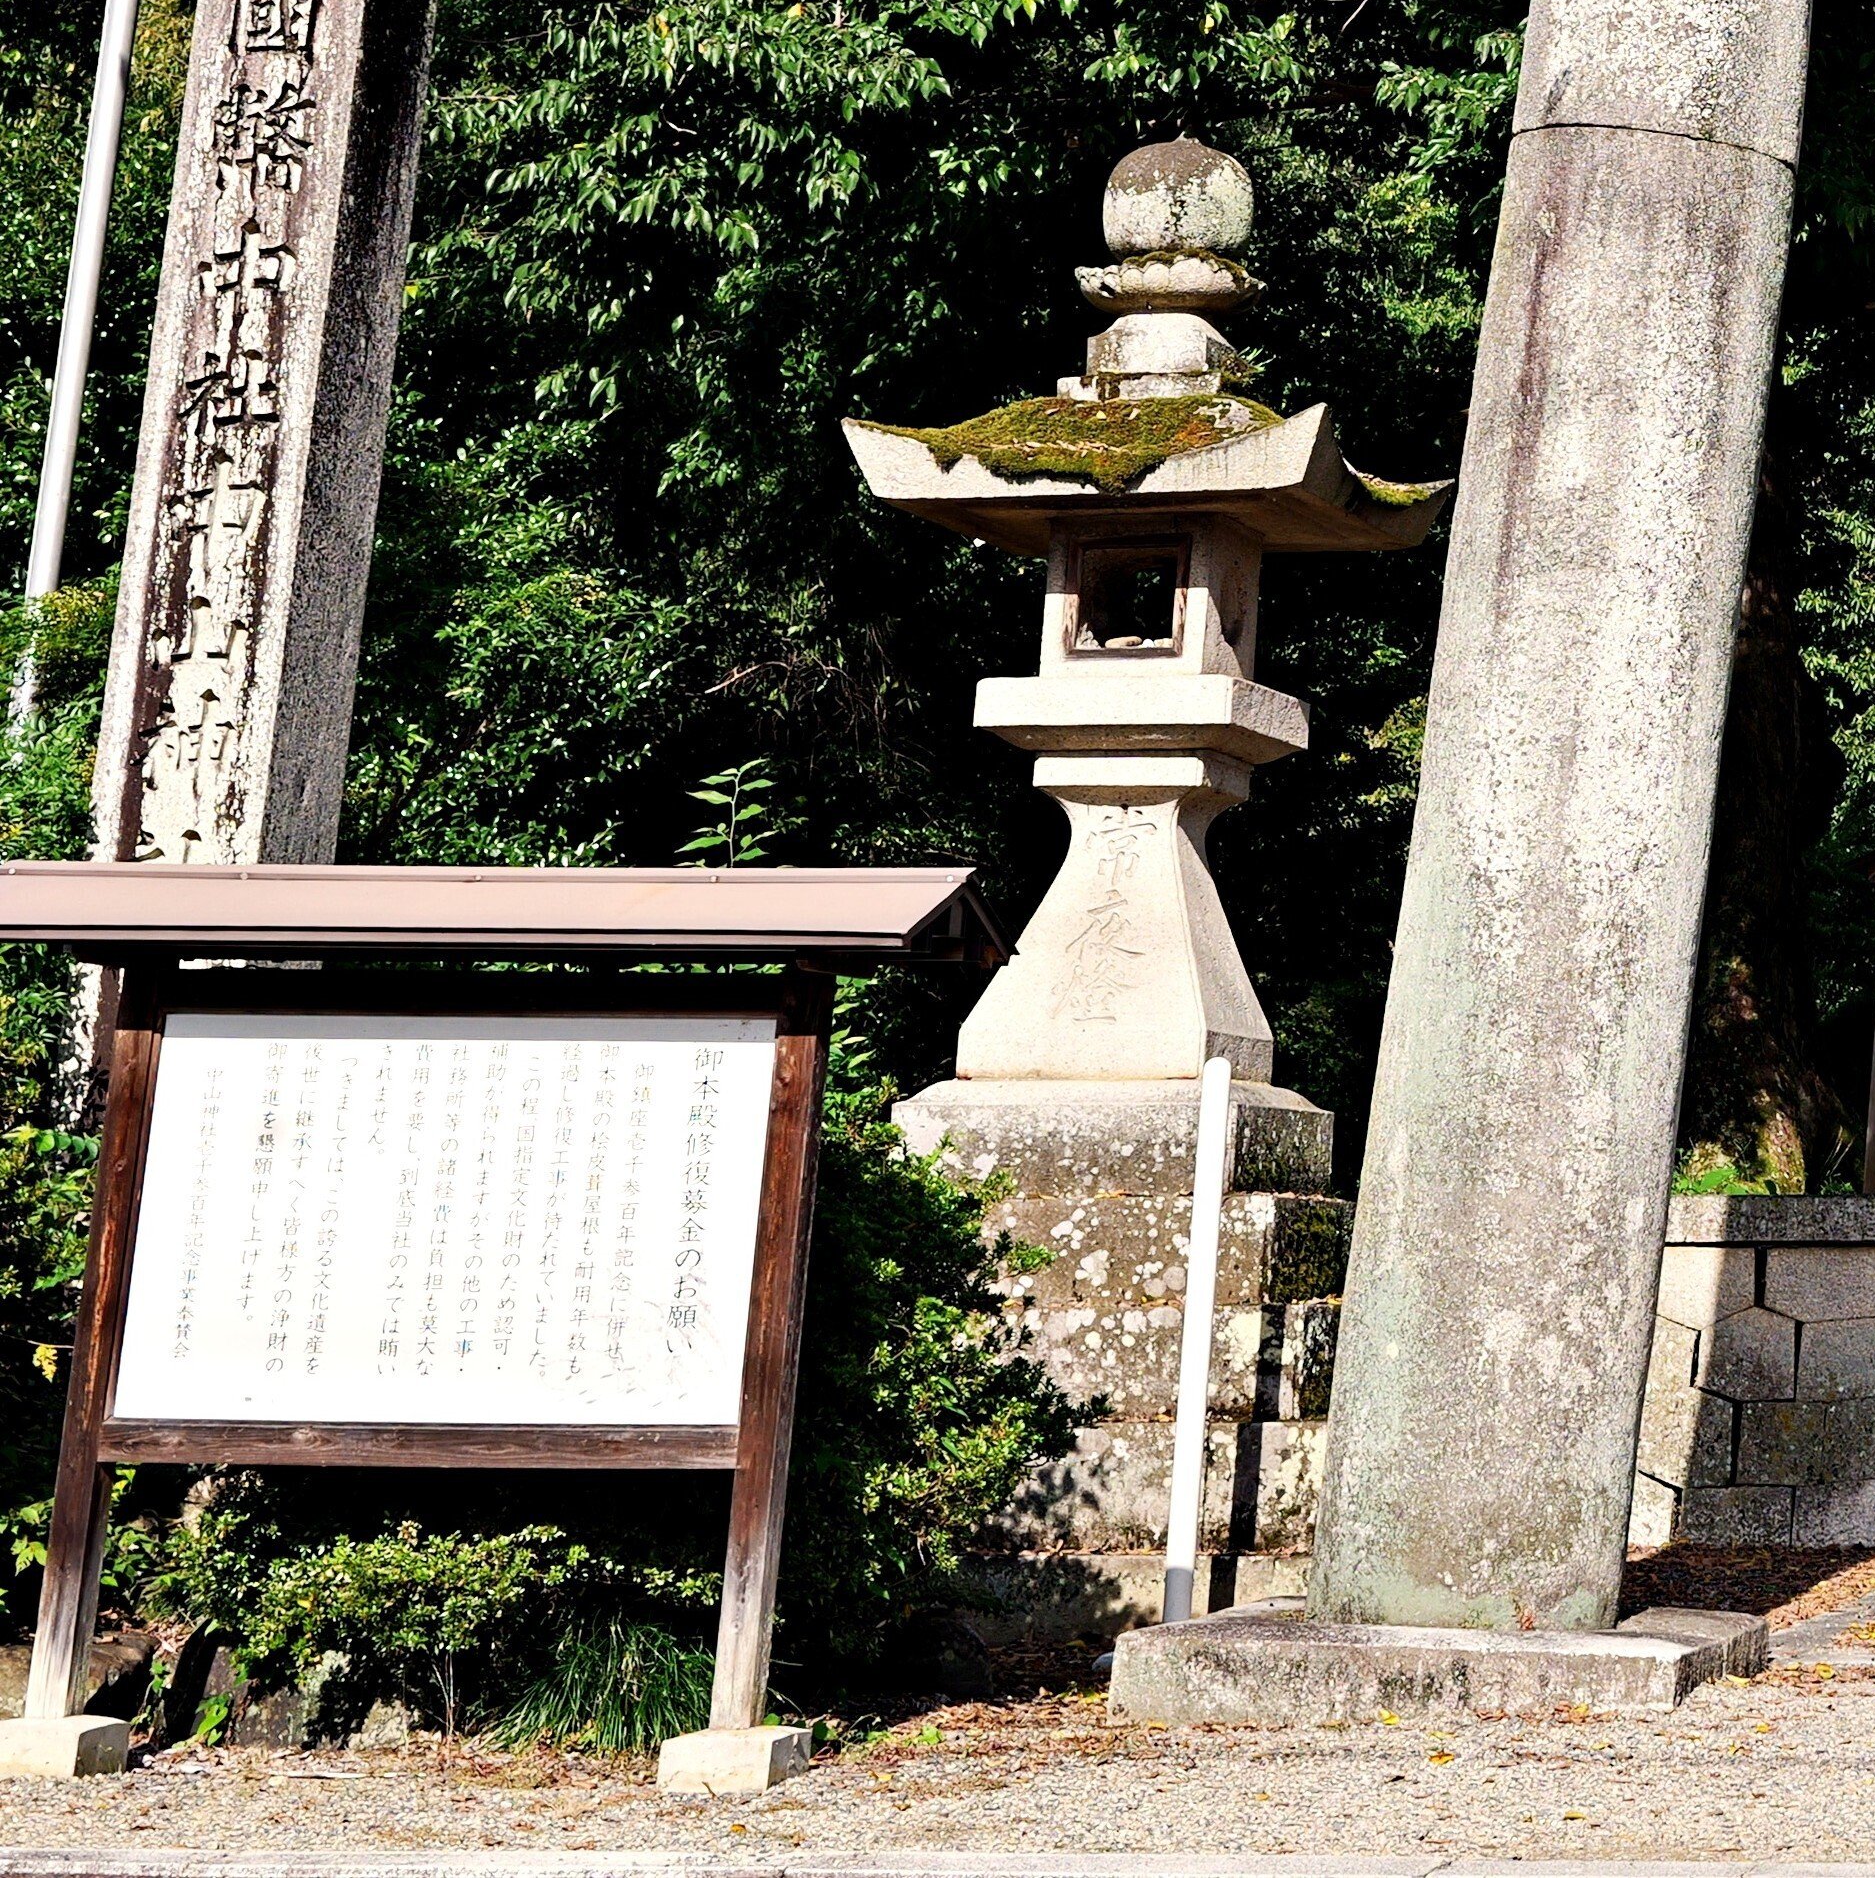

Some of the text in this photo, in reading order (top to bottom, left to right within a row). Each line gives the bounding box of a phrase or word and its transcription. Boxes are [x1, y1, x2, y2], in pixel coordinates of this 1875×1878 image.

[666, 1047, 724, 1358] 御本殿修復募金のお願い
